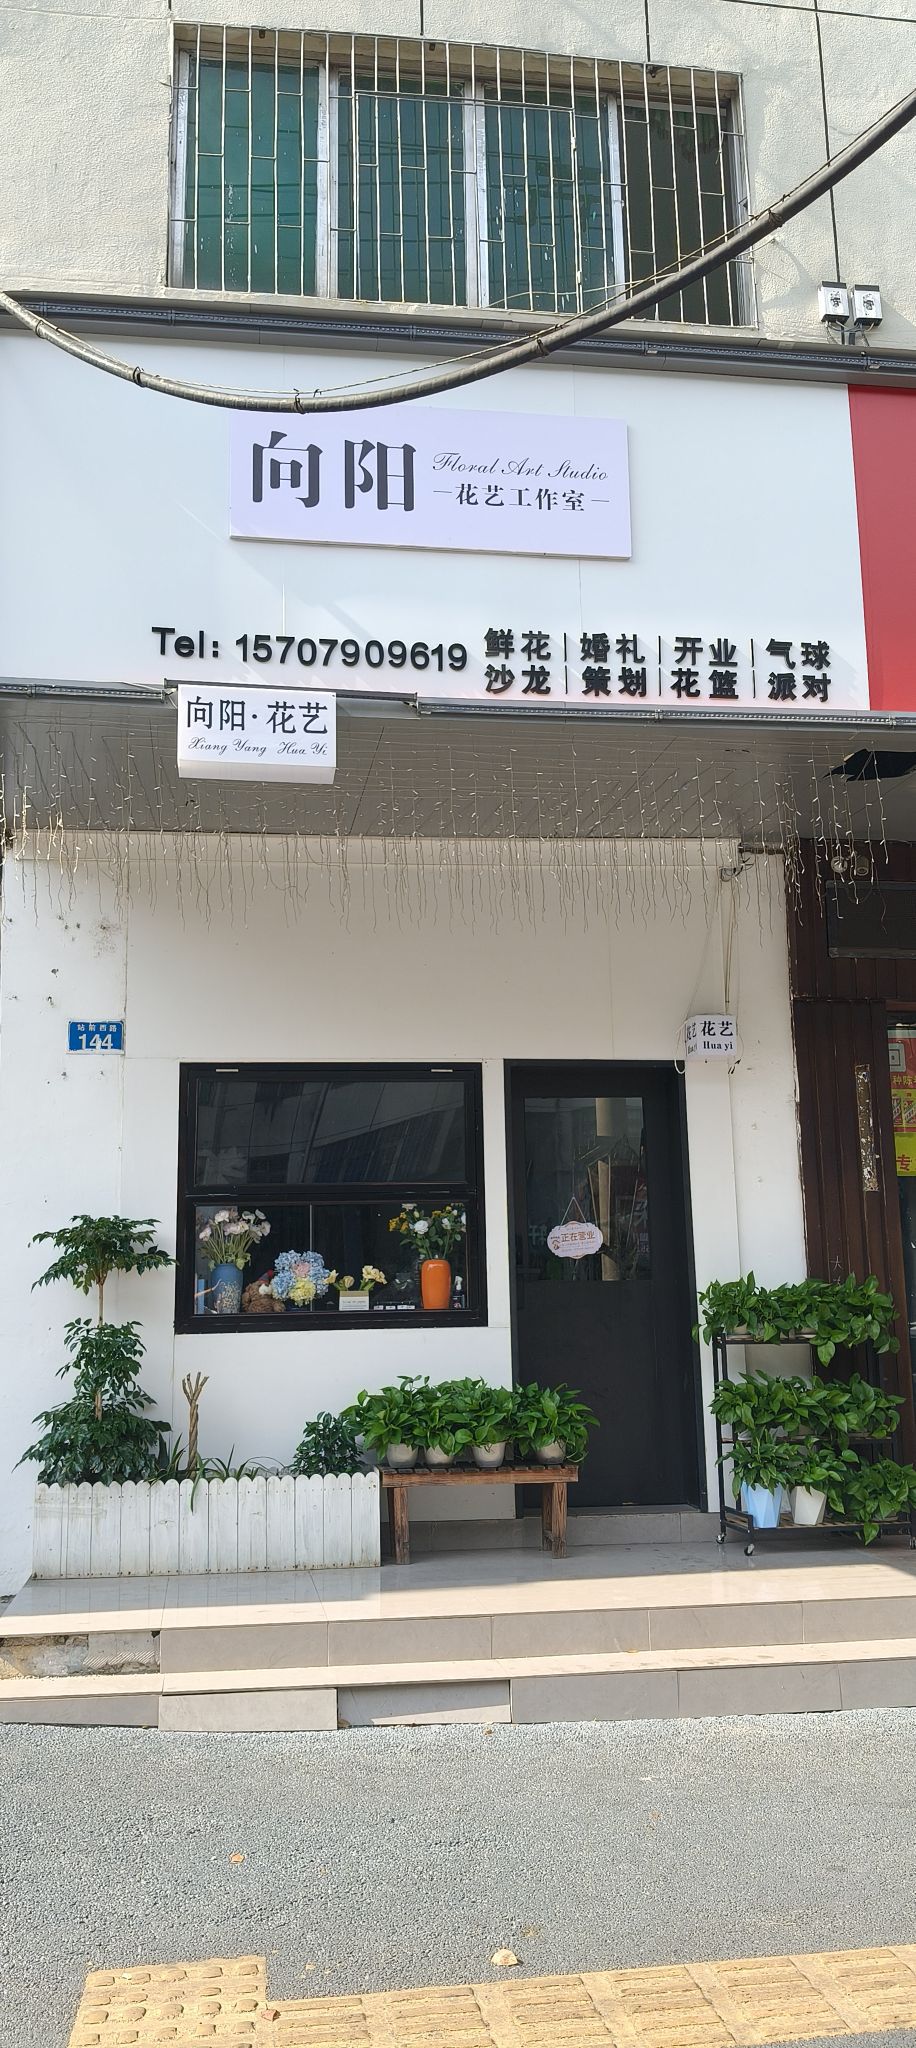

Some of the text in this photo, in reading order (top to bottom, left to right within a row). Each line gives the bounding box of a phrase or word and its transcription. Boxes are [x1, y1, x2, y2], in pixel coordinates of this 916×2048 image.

[252, 430, 417, 512] 向阳
[432, 452, 608, 481] Floral Art Studio
[151, 626, 468, 672] Tel: 15707909619
[187, 695, 328, 735] 向阳·花艺
[187, 736, 328, 758] Xiang Yang Hua Yi
[700, 1020, 734, 1036] 花艺
[78, 1033, 114, 1050] 144
[724, 1041, 734, 1051] yi
[560, 1231, 596, 1242] 正在营业
